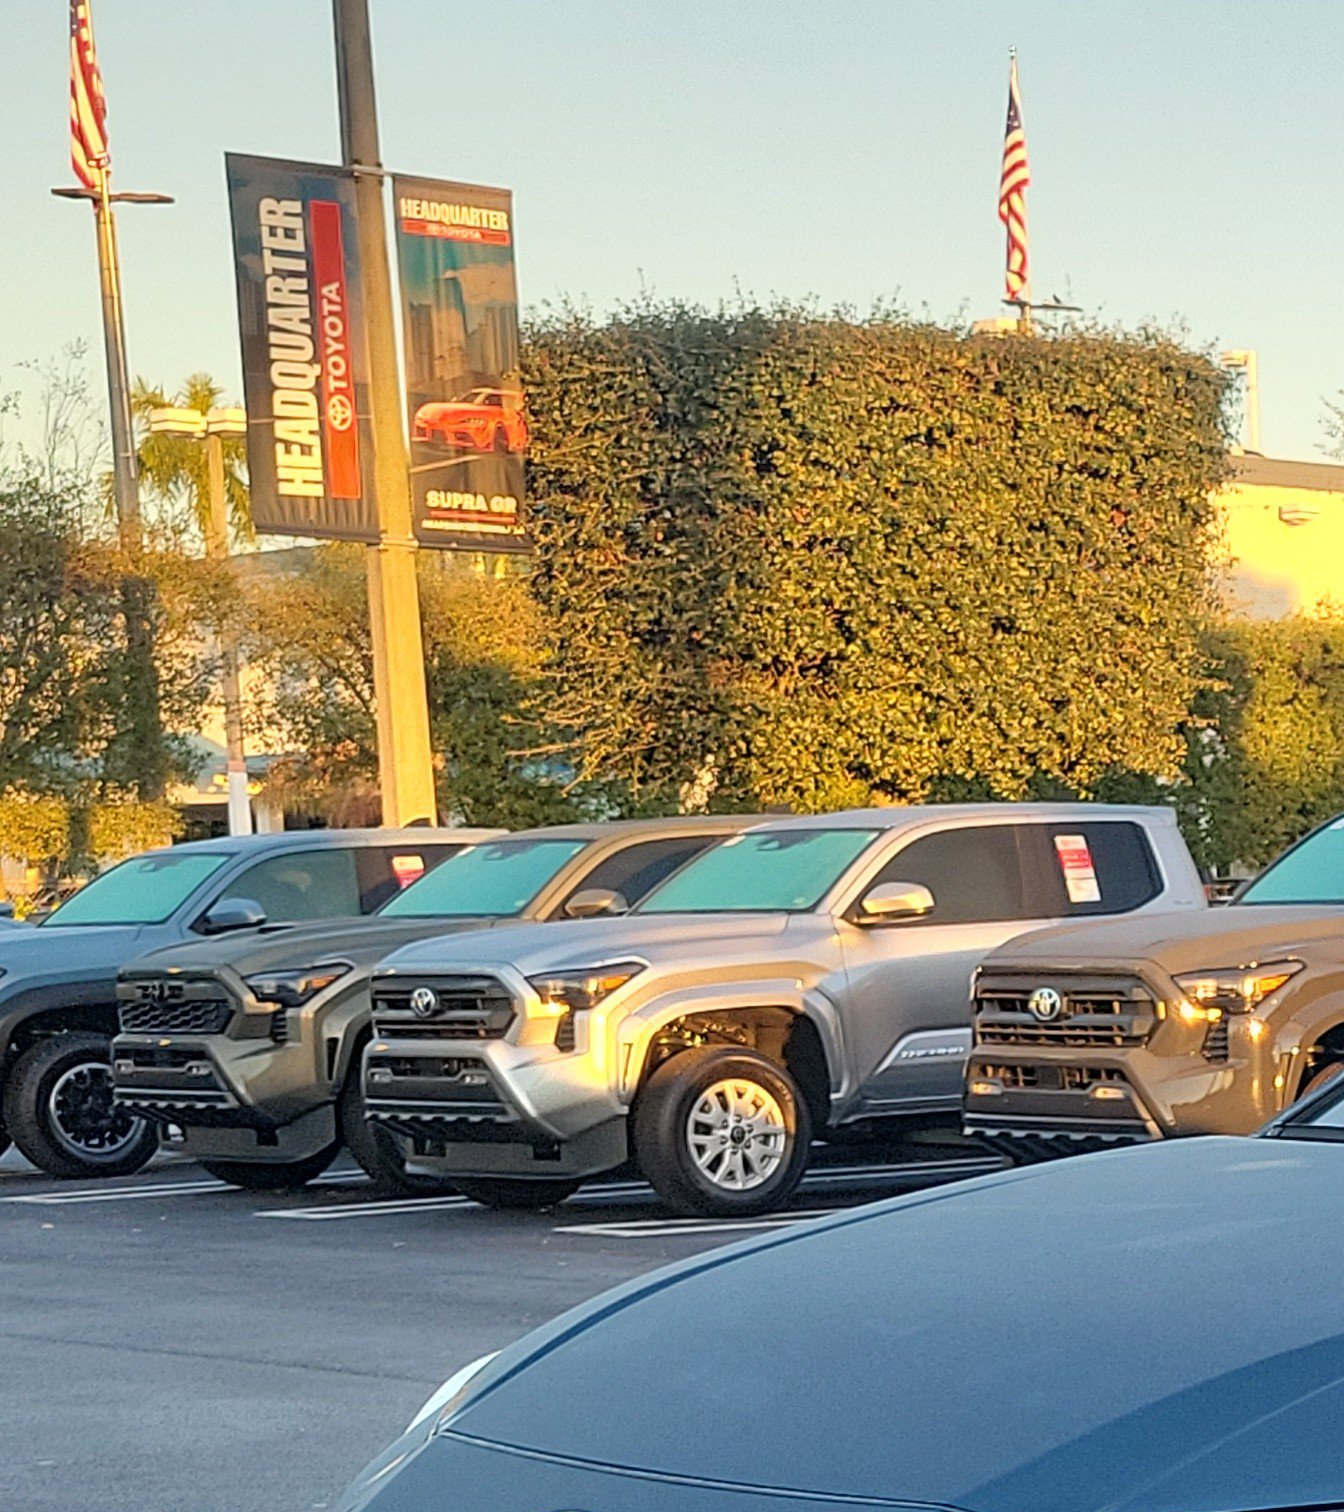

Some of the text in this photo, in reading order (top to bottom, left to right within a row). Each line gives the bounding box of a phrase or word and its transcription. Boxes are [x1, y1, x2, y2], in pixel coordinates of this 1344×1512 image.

[400, 198, 509, 231] HEADQUARTER
[259, 197, 325, 497] HEADQUARTER
[321, 281, 349, 392] TOYOTA
[426, 490, 489, 512] SUPRA
